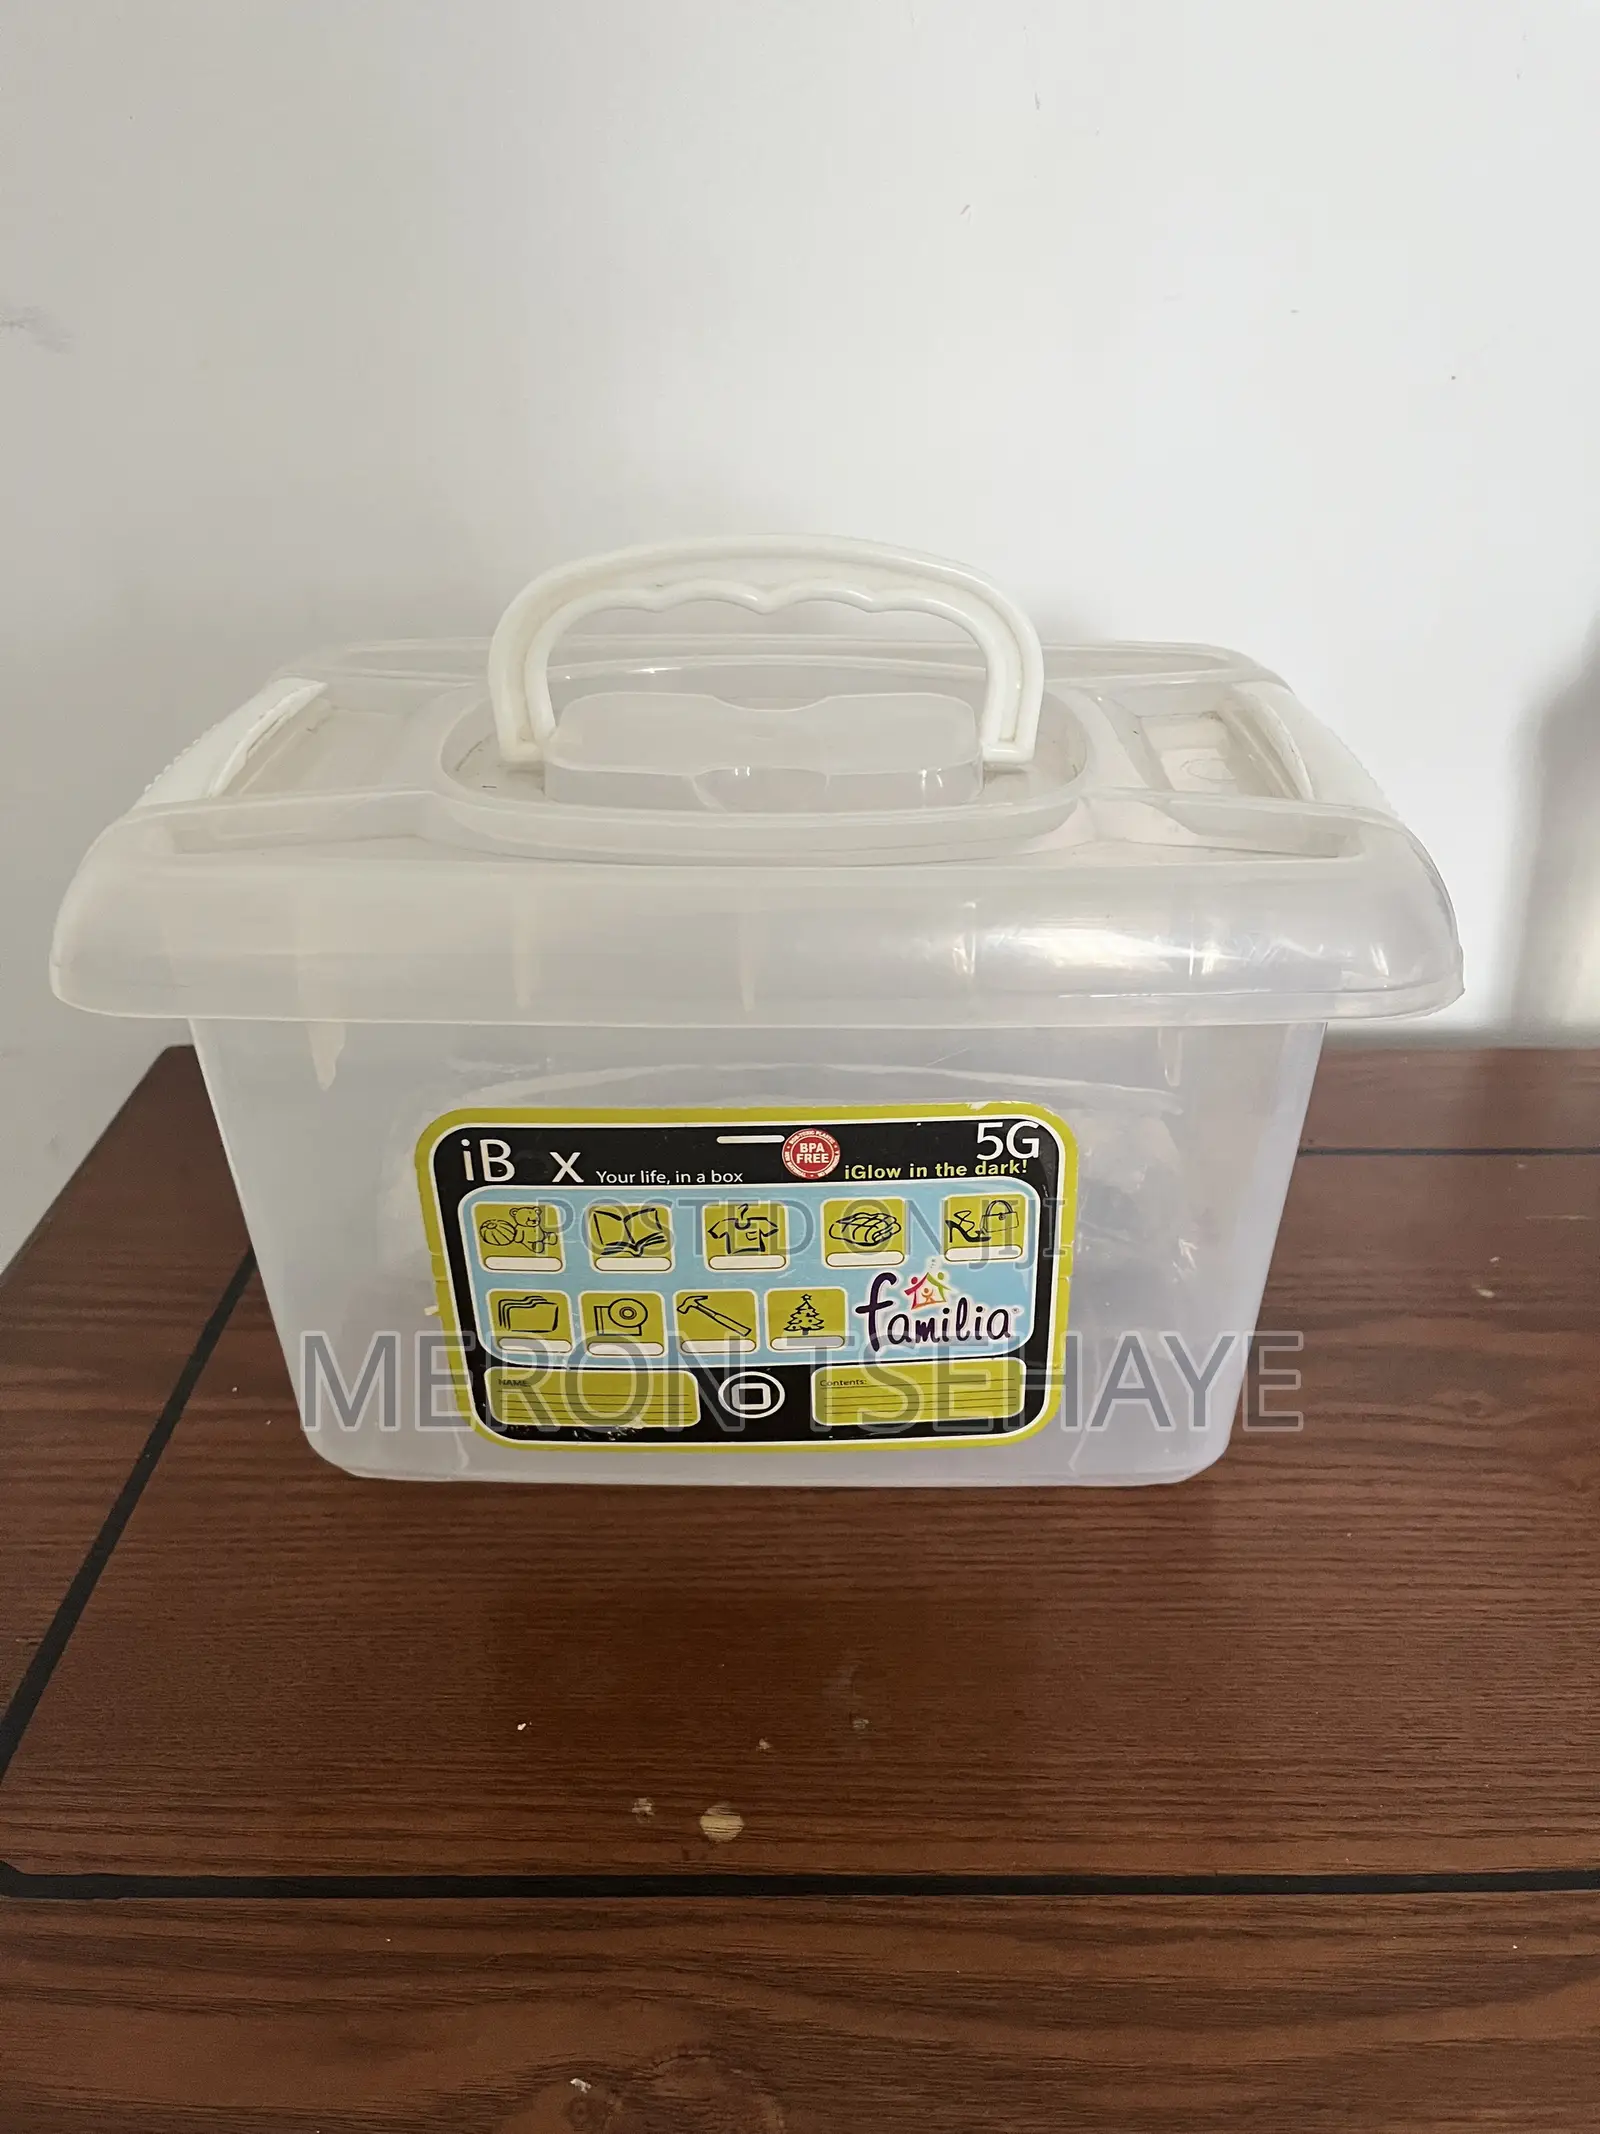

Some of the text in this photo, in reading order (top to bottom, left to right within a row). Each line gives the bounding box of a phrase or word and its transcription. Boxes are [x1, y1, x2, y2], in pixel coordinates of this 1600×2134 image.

[799, 1142, 825, 1153] BPA
[976, 1121, 1040, 1160] 5G
[796, 1153, 830, 1164] FREE
[595, 1169, 744, 1185] Your life, in a box
[844, 1164, 901, 1180] iGlow
[909, 1163, 928, 1178] in
[936, 1162, 968, 1177] the
[974, 1159, 1028, 1176] dark!
[855, 1271, 1012, 1352] familia
[820, 1379, 868, 1387] Contents:
